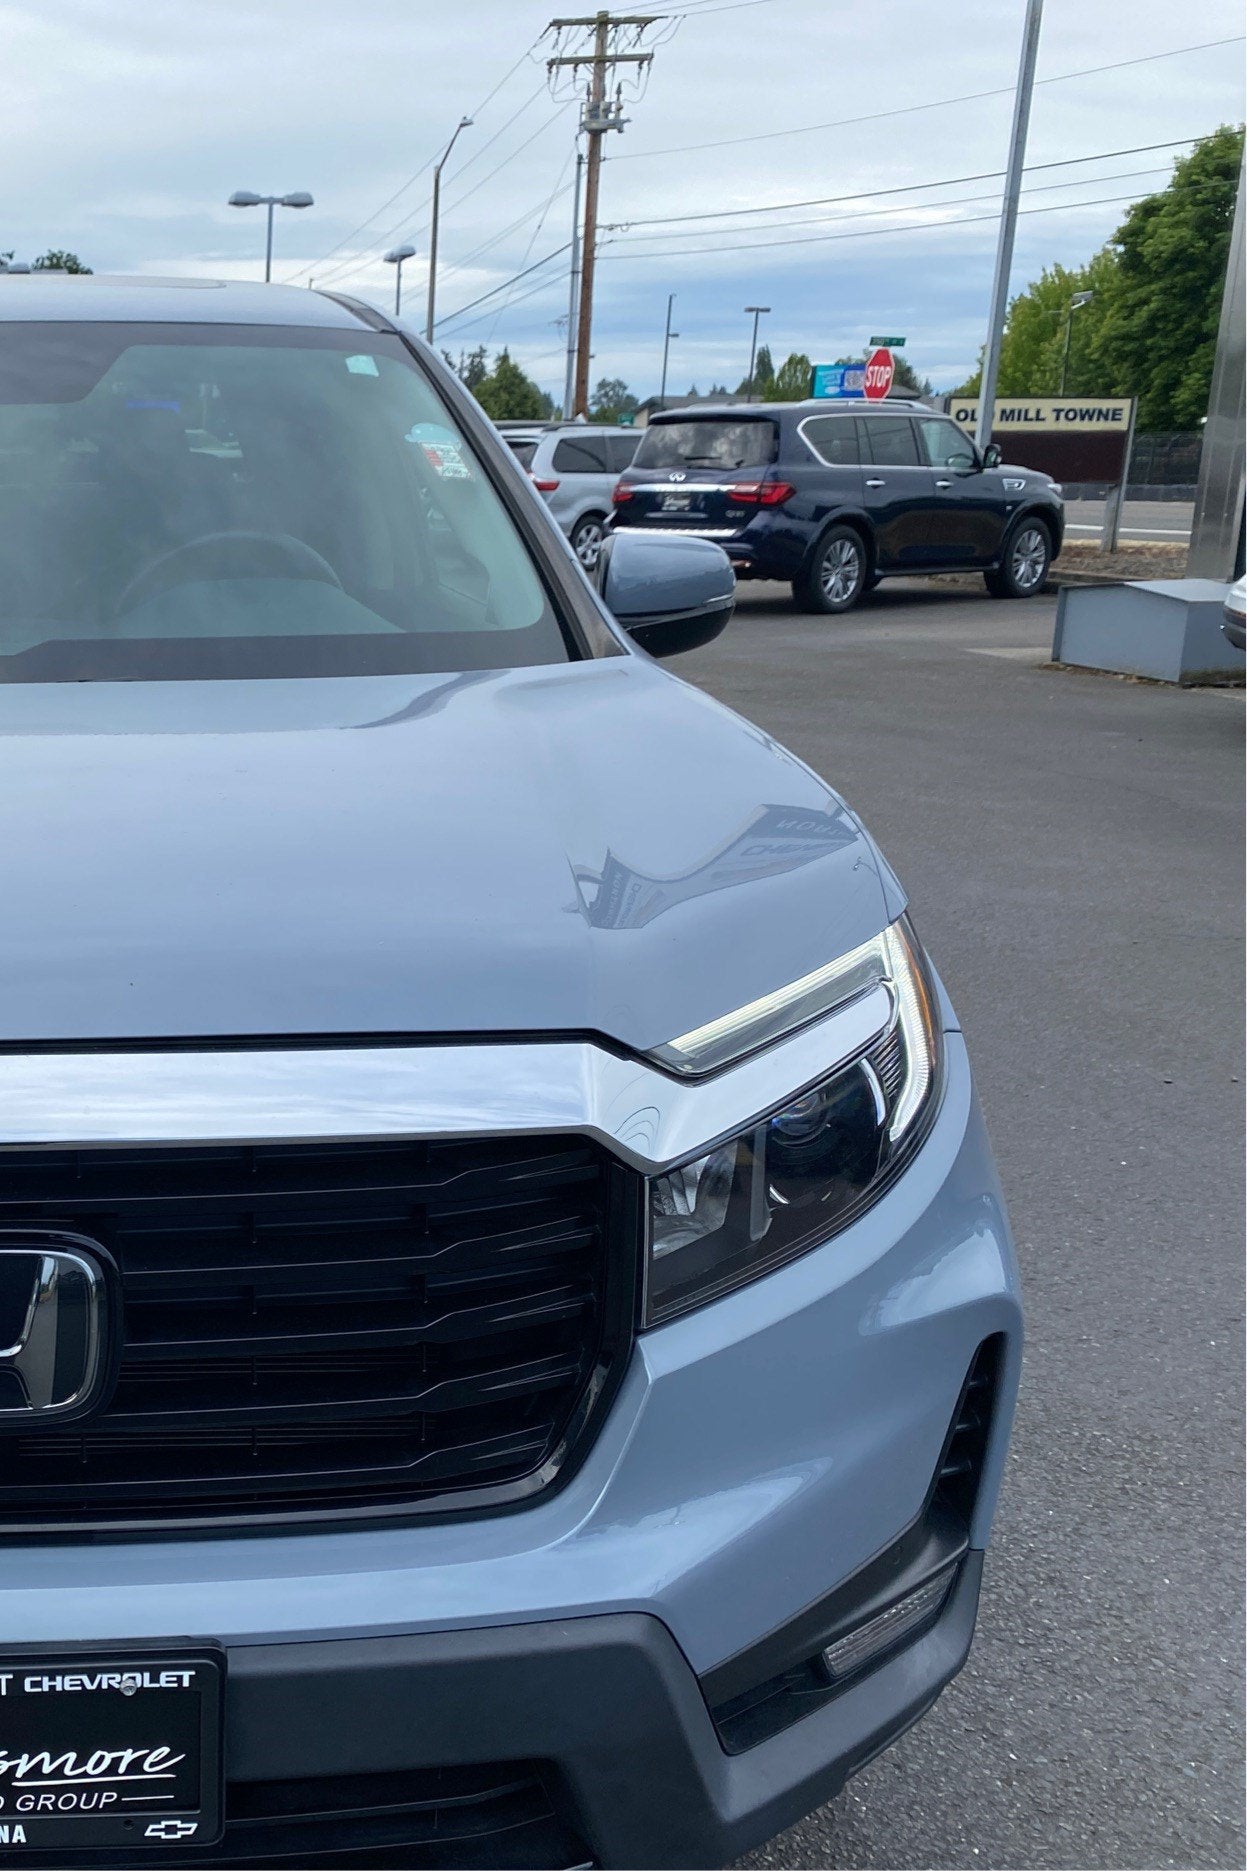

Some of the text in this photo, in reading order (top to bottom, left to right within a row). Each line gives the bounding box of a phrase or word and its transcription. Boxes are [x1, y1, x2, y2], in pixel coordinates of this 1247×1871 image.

[865, 365, 892, 388] STOP
[999, 408, 1047, 422] MILL
[1052, 408, 1124, 422] TOWNE
[23, 1670, 196, 1693] CHEVROLET
[15, 1791, 118, 1812] GROUP
